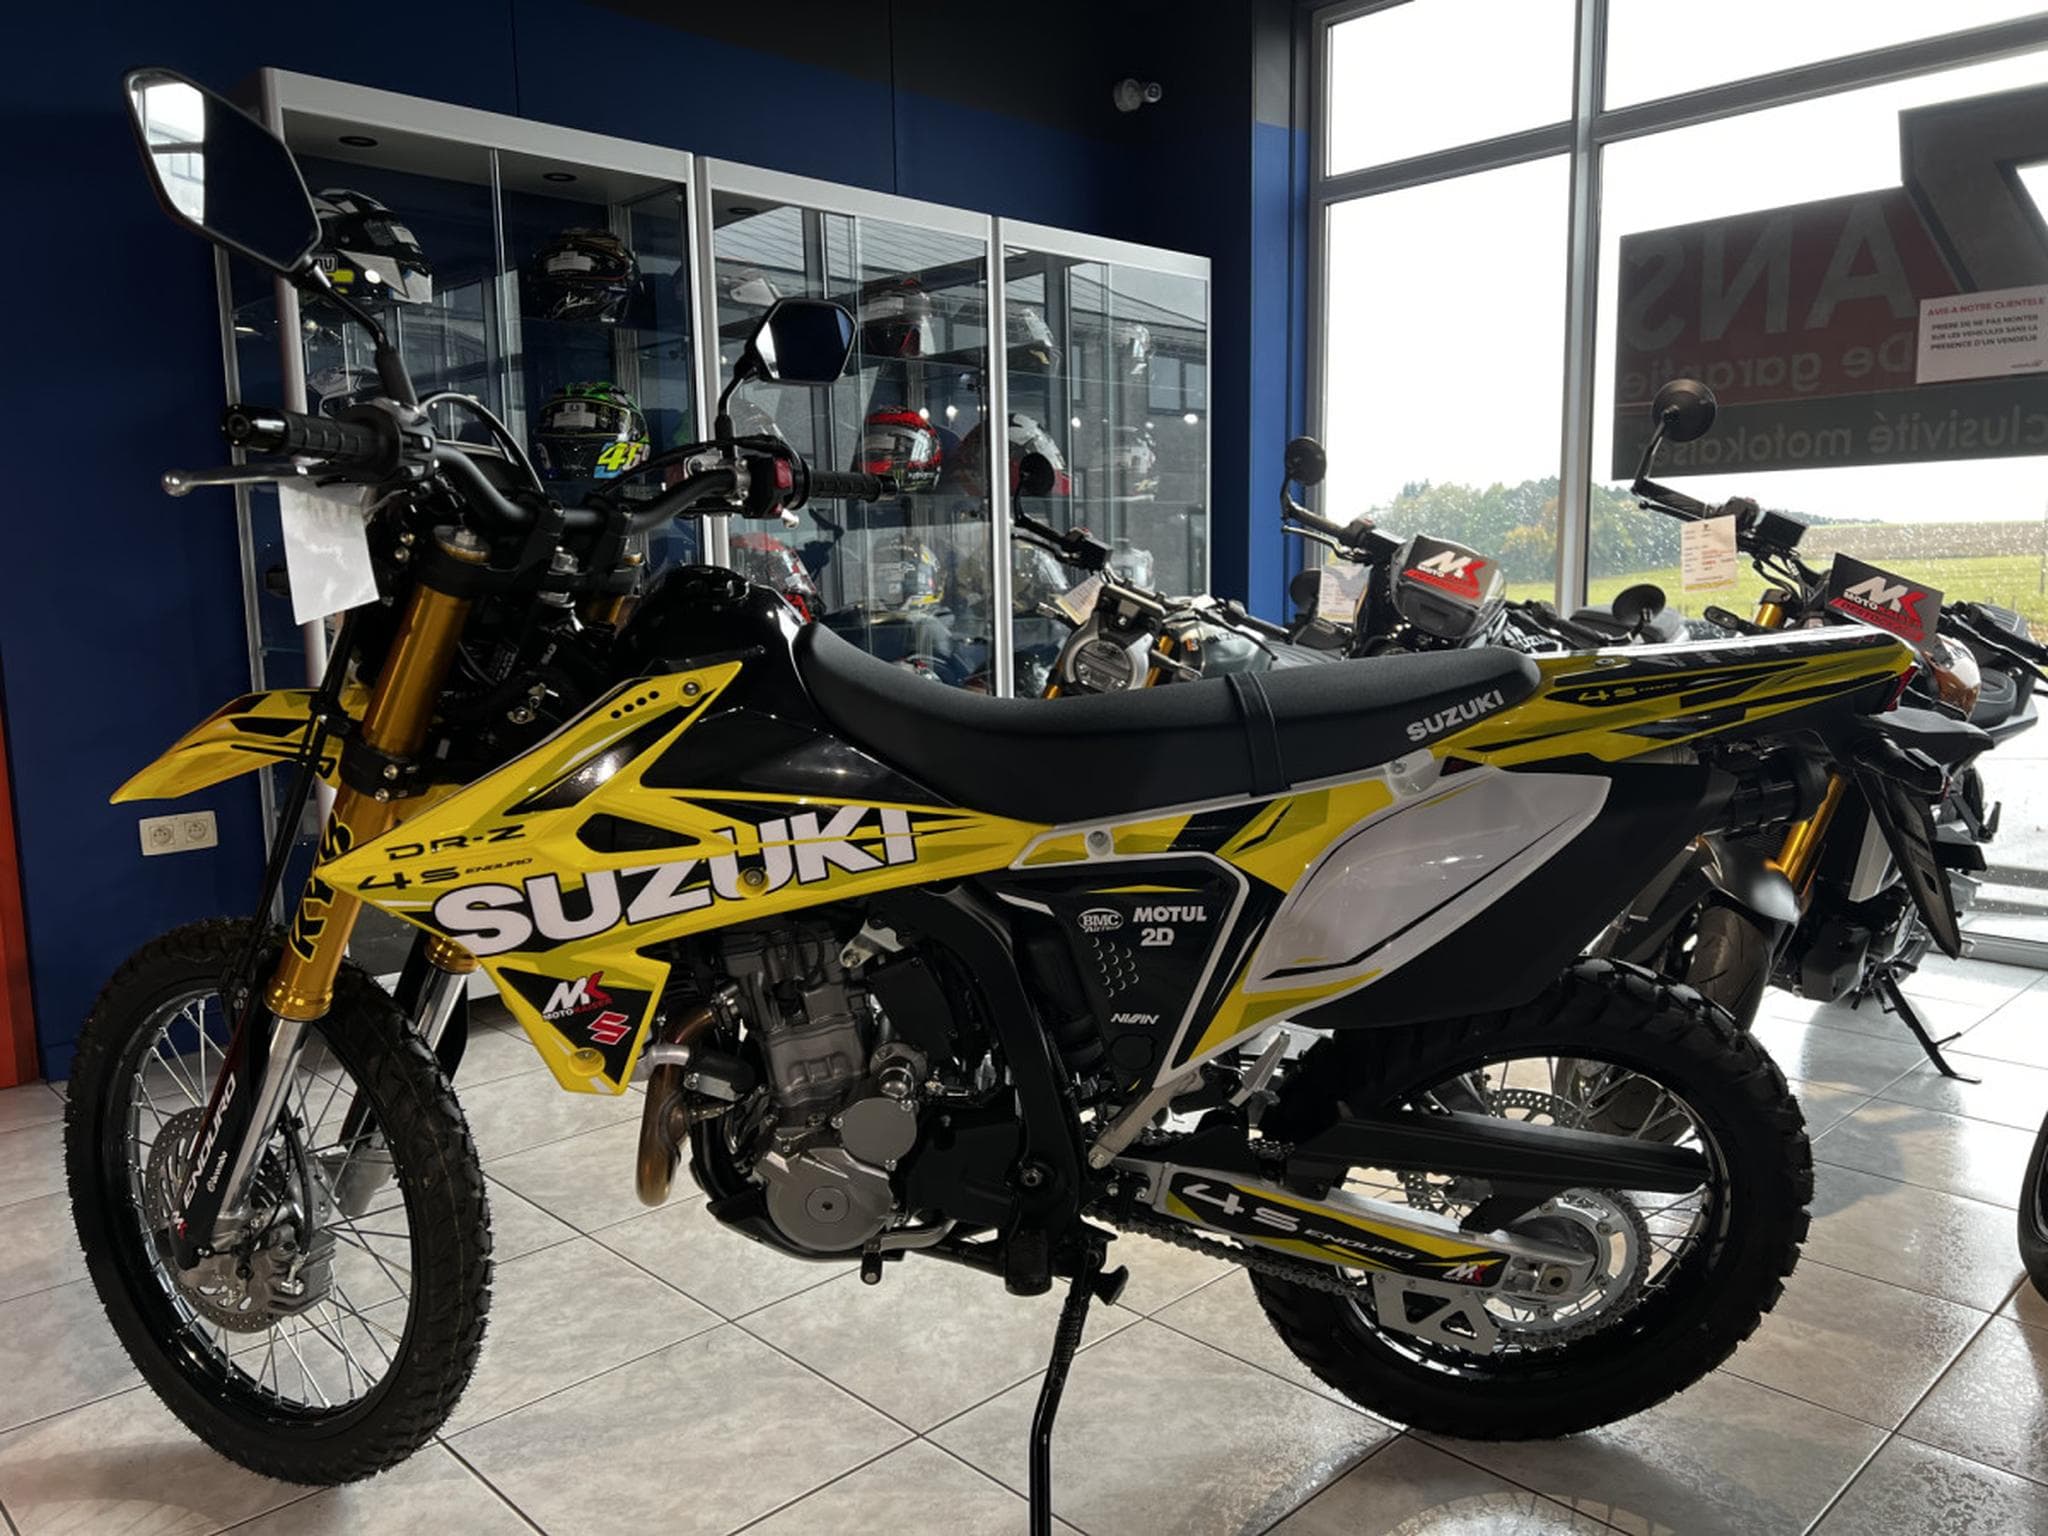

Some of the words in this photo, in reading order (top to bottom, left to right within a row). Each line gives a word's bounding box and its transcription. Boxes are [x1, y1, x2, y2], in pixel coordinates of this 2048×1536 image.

[1406, 690, 1504, 742] SUZUKI
[385, 824, 526, 860] DR-Z
[433, 804, 917, 957] SUZUKI
[465, 857, 533, 874] ENDURO
[1082, 913, 1119, 927] BMC
[1133, 906, 1208, 922] MOTUL
[1140, 927, 1175, 946] 2D
[184, 1071, 236, 1209] ENDURO
[1181, 1183, 1300, 1233] 4S
[1304, 1228, 1416, 1261] ENDURO
